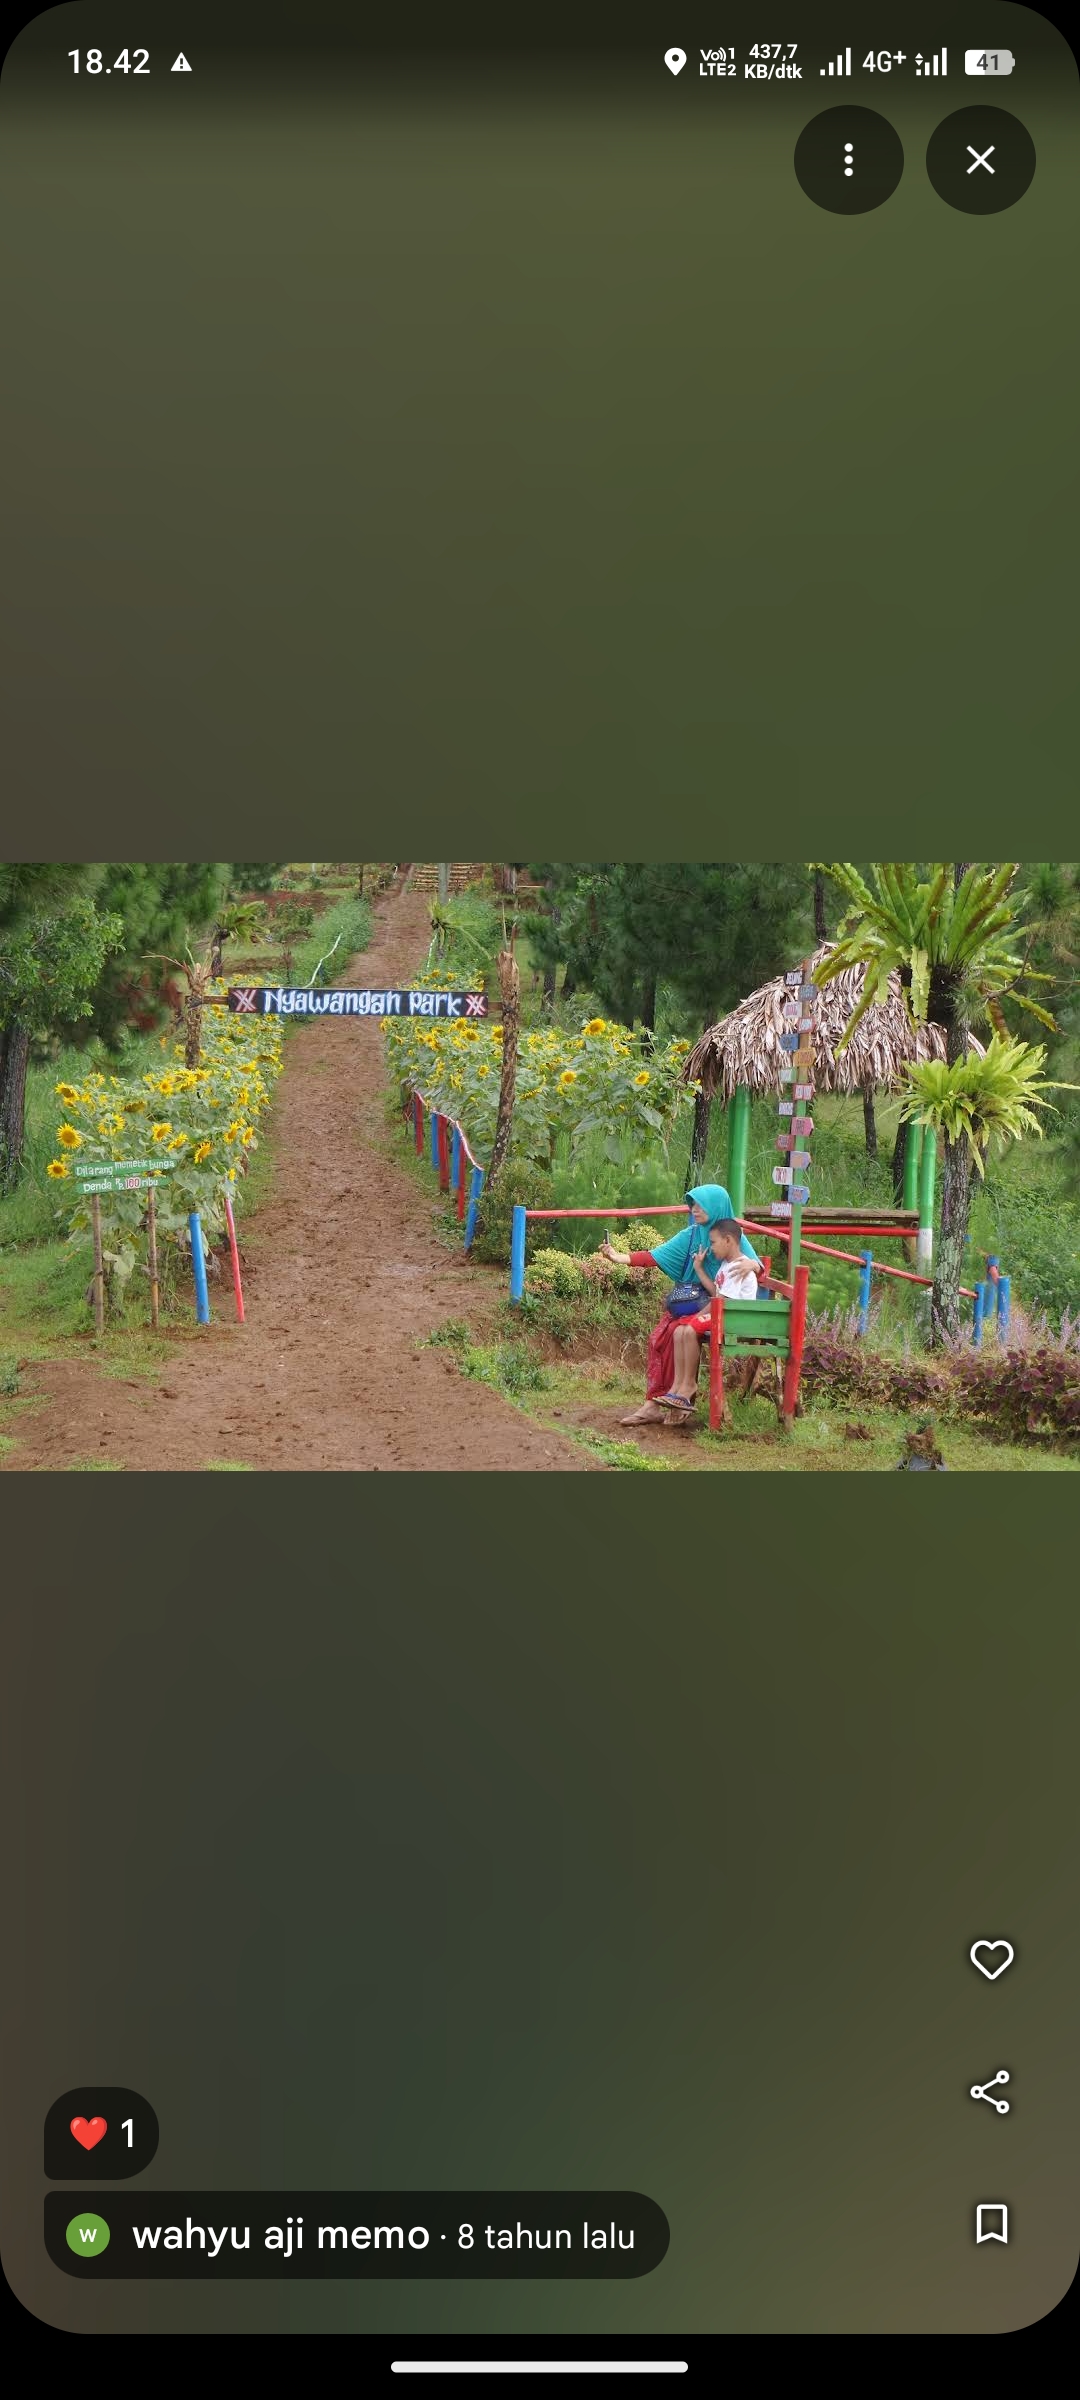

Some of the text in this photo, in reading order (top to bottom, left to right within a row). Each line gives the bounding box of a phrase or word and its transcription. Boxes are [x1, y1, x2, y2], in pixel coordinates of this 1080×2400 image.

[263, 988, 401, 1014] Nyawangan
[76, 1159, 175, 1177] Dilarang memetik bunga
[83, 1179, 112, 1192] Denda
